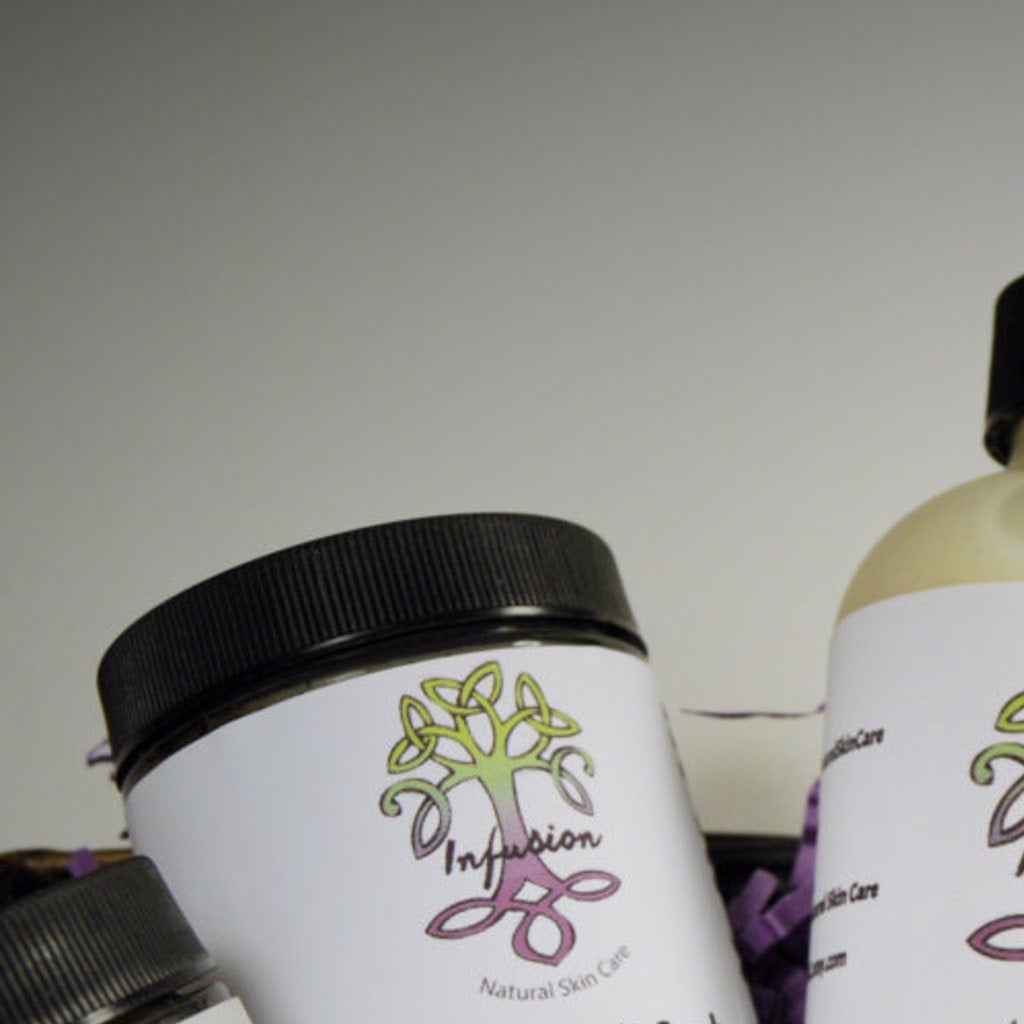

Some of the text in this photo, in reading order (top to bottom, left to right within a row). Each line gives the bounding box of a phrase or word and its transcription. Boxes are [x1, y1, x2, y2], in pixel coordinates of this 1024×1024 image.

[443, 825, 603, 890] Infusion
[478, 943, 632, 1002] Natural Skin Care
